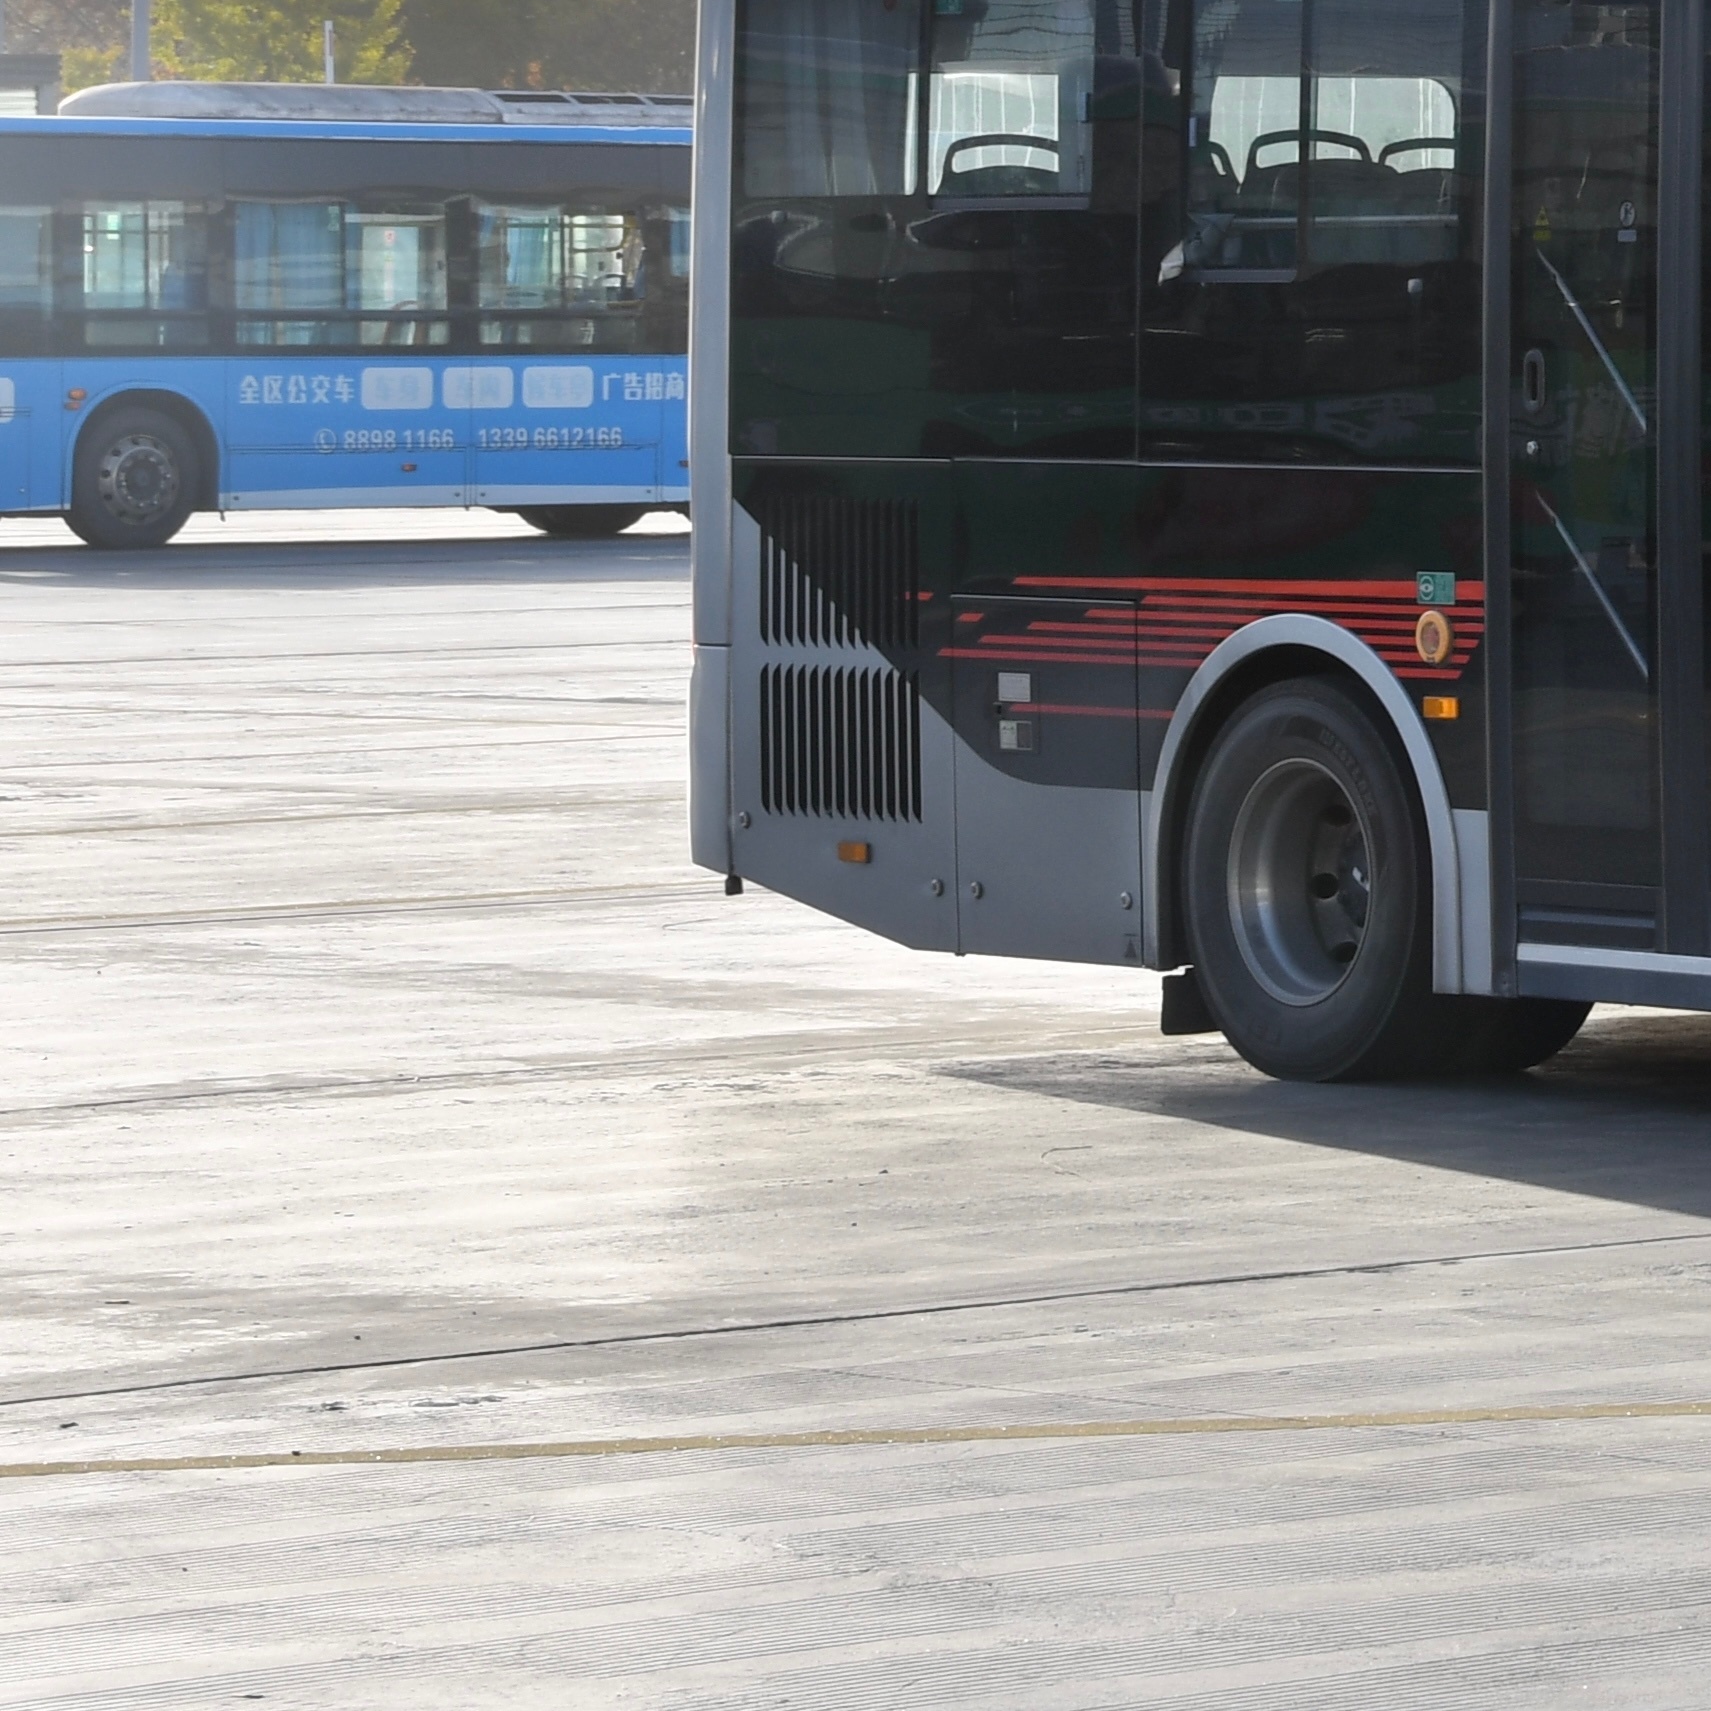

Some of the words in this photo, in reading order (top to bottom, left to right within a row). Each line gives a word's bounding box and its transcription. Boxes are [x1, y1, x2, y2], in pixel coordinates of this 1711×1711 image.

[239, 374, 354, 404] 全区公交车
[602, 372, 685, 401] 广告招商
[343, 429, 397, 450] 8898
[403, 428, 455, 449] 1166
[478, 427, 528, 448] 1339
[533, 426, 623, 448] 6612166
